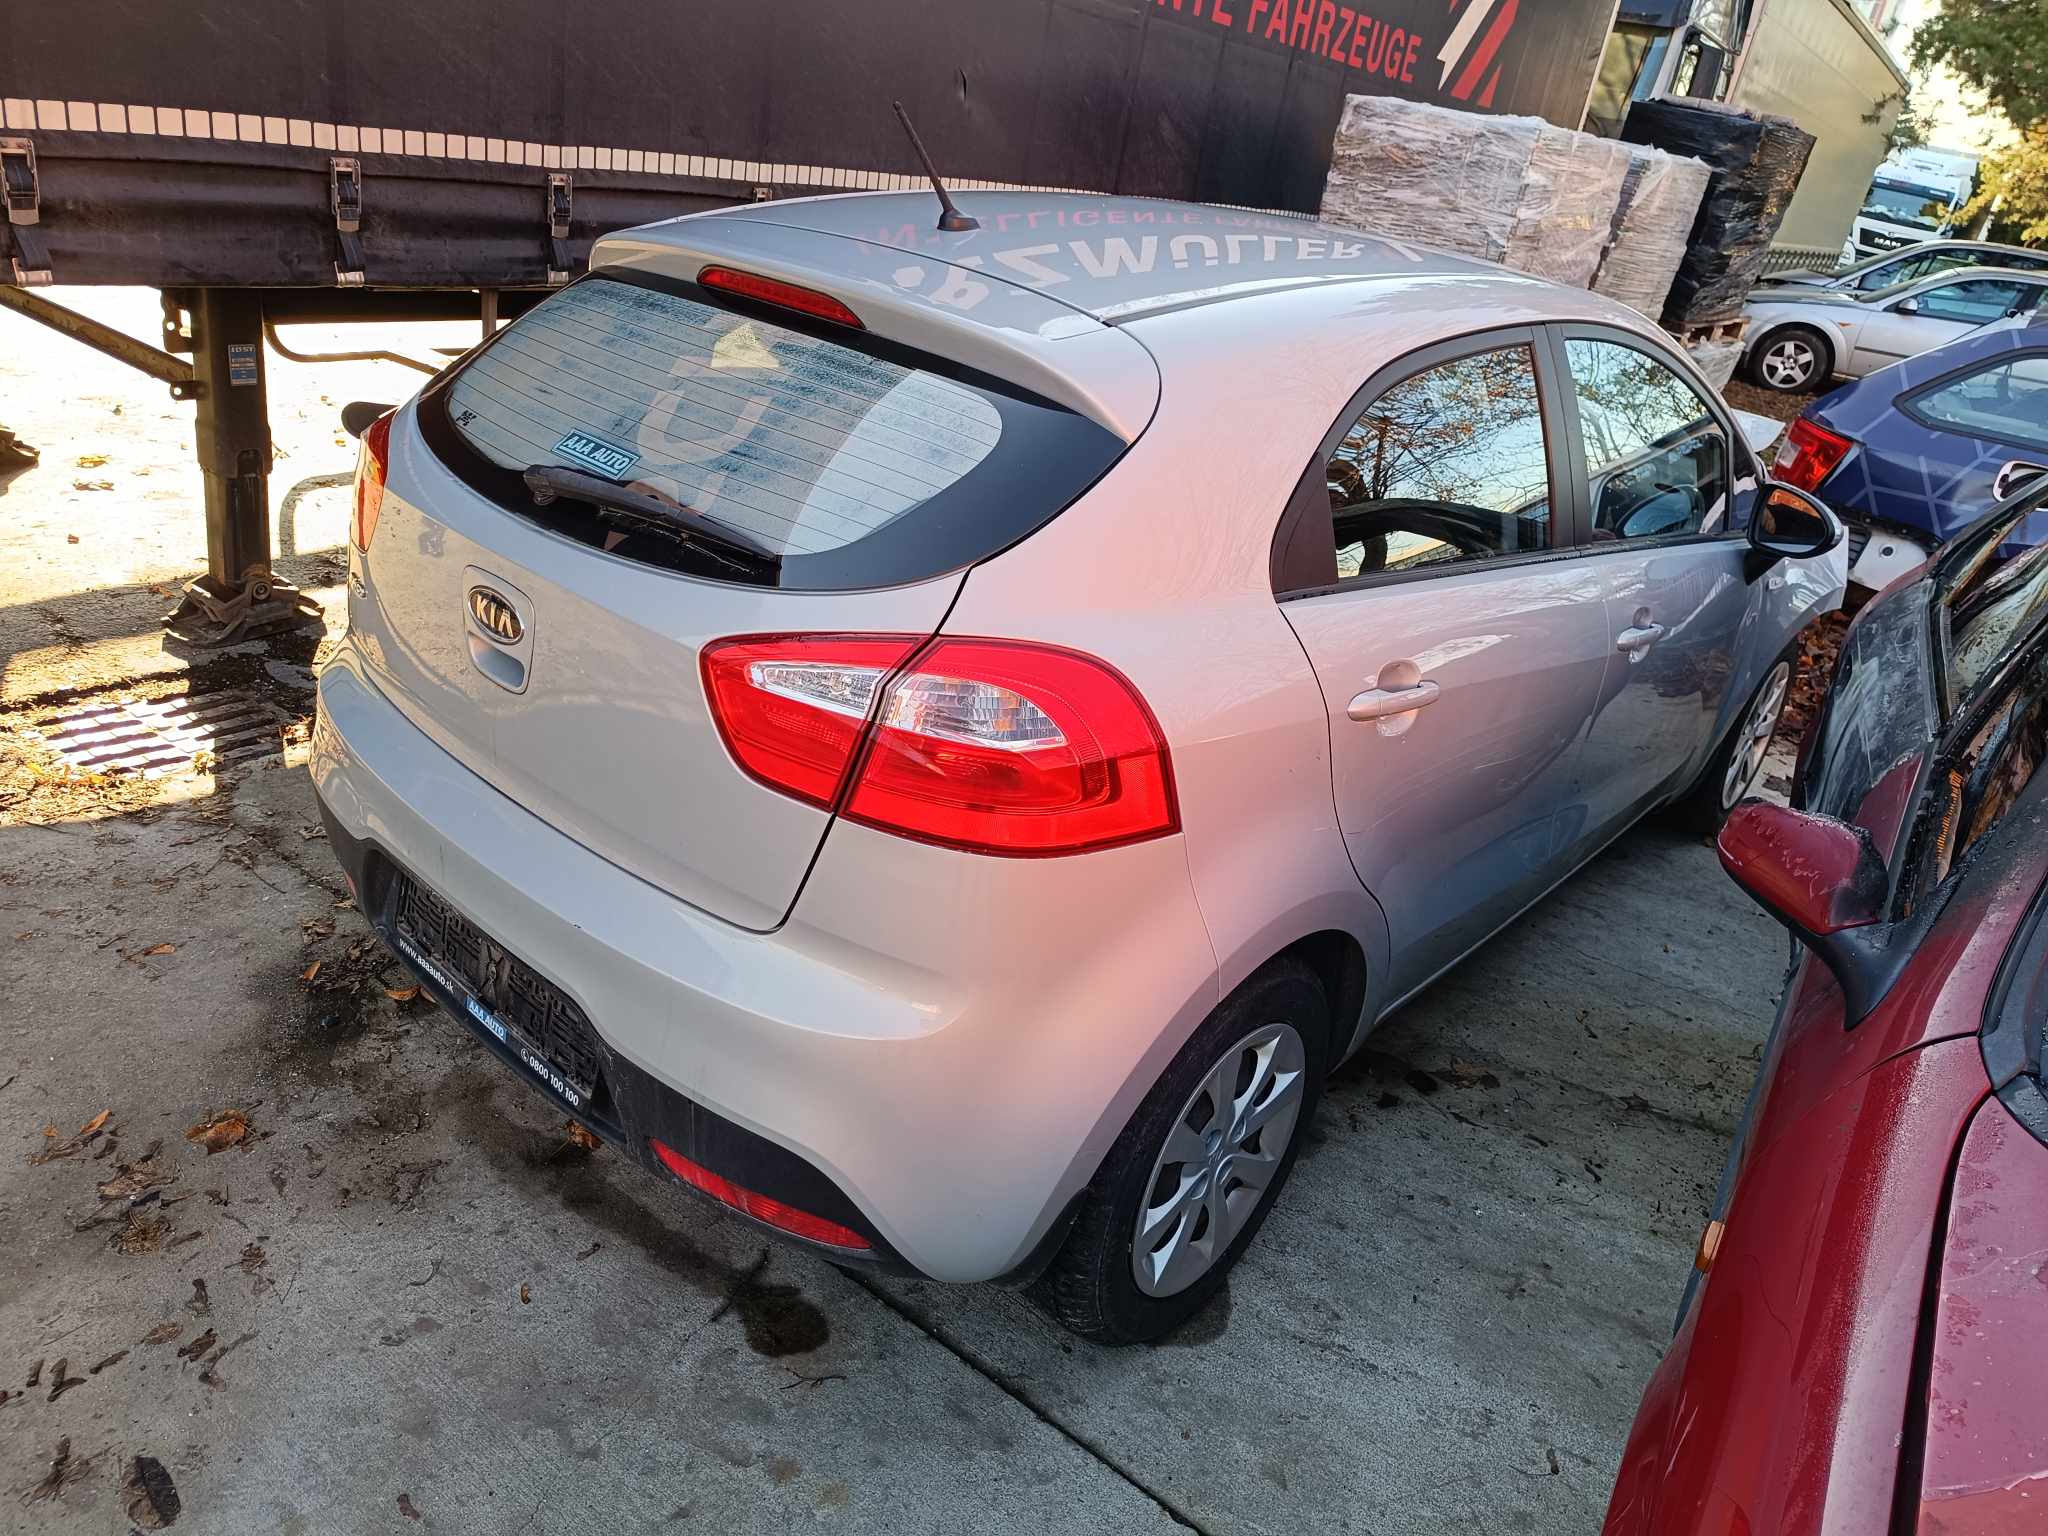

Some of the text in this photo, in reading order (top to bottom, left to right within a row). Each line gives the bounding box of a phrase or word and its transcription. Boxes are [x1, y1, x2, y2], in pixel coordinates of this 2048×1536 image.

[1247, 0, 1422, 84] FAHRZEUGE
[1874, 237, 1902, 248] MAN
[562, 435, 630, 470] AAA AUTO
[475, 594, 514, 639] KIA
[399, 937, 455, 995] www.aaaauto.sk
[467, 1001, 505, 1040] AAA AUTO
[529, 1055, 579, 1107] 0800 100 100
